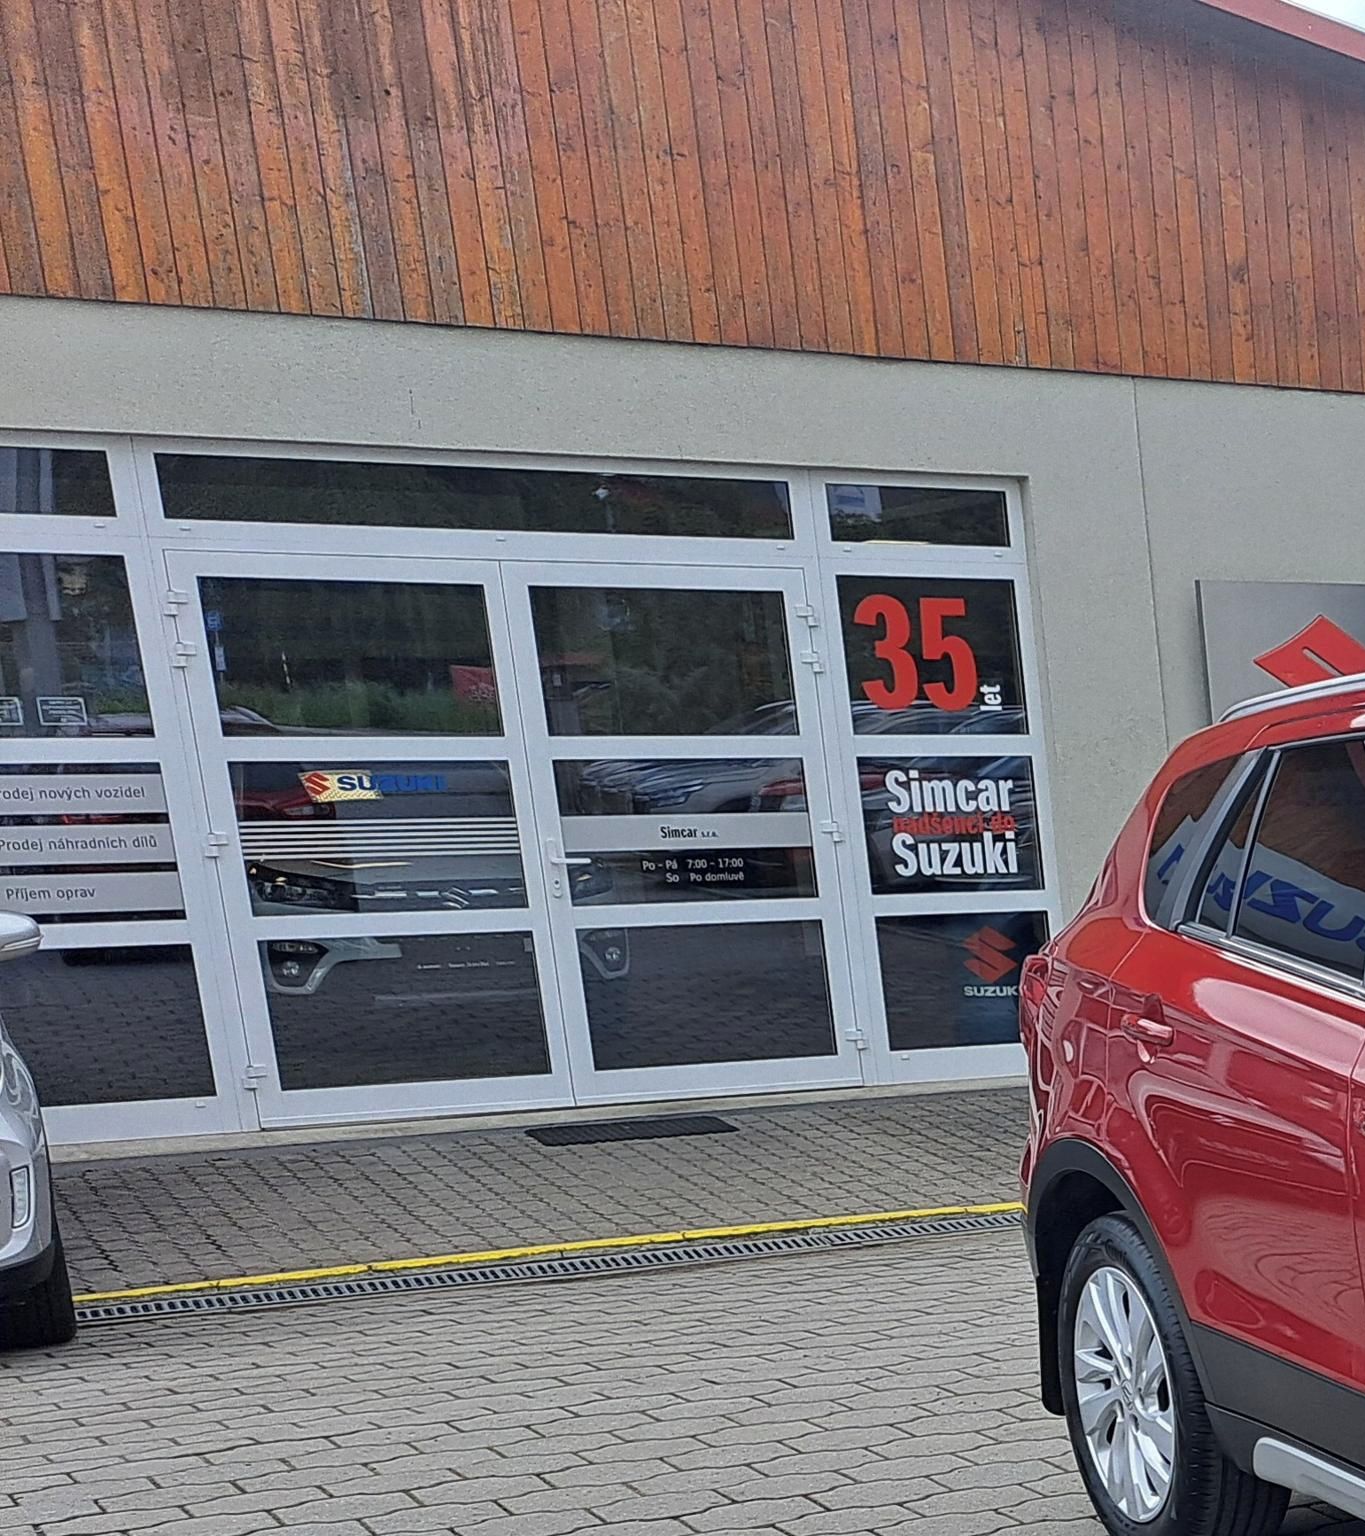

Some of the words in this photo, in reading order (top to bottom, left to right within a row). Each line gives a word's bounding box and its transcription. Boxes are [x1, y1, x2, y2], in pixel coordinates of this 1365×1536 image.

[854, 594, 978, 712] 35
[980, 684, 1003, 711] let
[0, 787, 34, 801] odej
[39, 786, 91, 801] nových
[96, 786, 146, 799] vozidel
[885, 769, 1014, 813] Simcar
[660, 826, 698, 838] Simcar
[48, 836, 128, 851] náhradních
[132, 835, 157, 849] dílů
[892, 831, 1018, 877] Suzuki
[642, 860, 656, 871] Po
[665, 858, 678, 870] Pá
[687, 859, 707, 869] 7:00
[719, 858, 744, 868] 17:00
[666, 873, 680, 883] So
[690, 873, 702, 882] Po
[705, 871, 745, 881] domluvě
[6, 888, 51, 901] Příjem
[56, 888, 96, 901] oprav
[963, 985, 1019, 997] SUZUK
